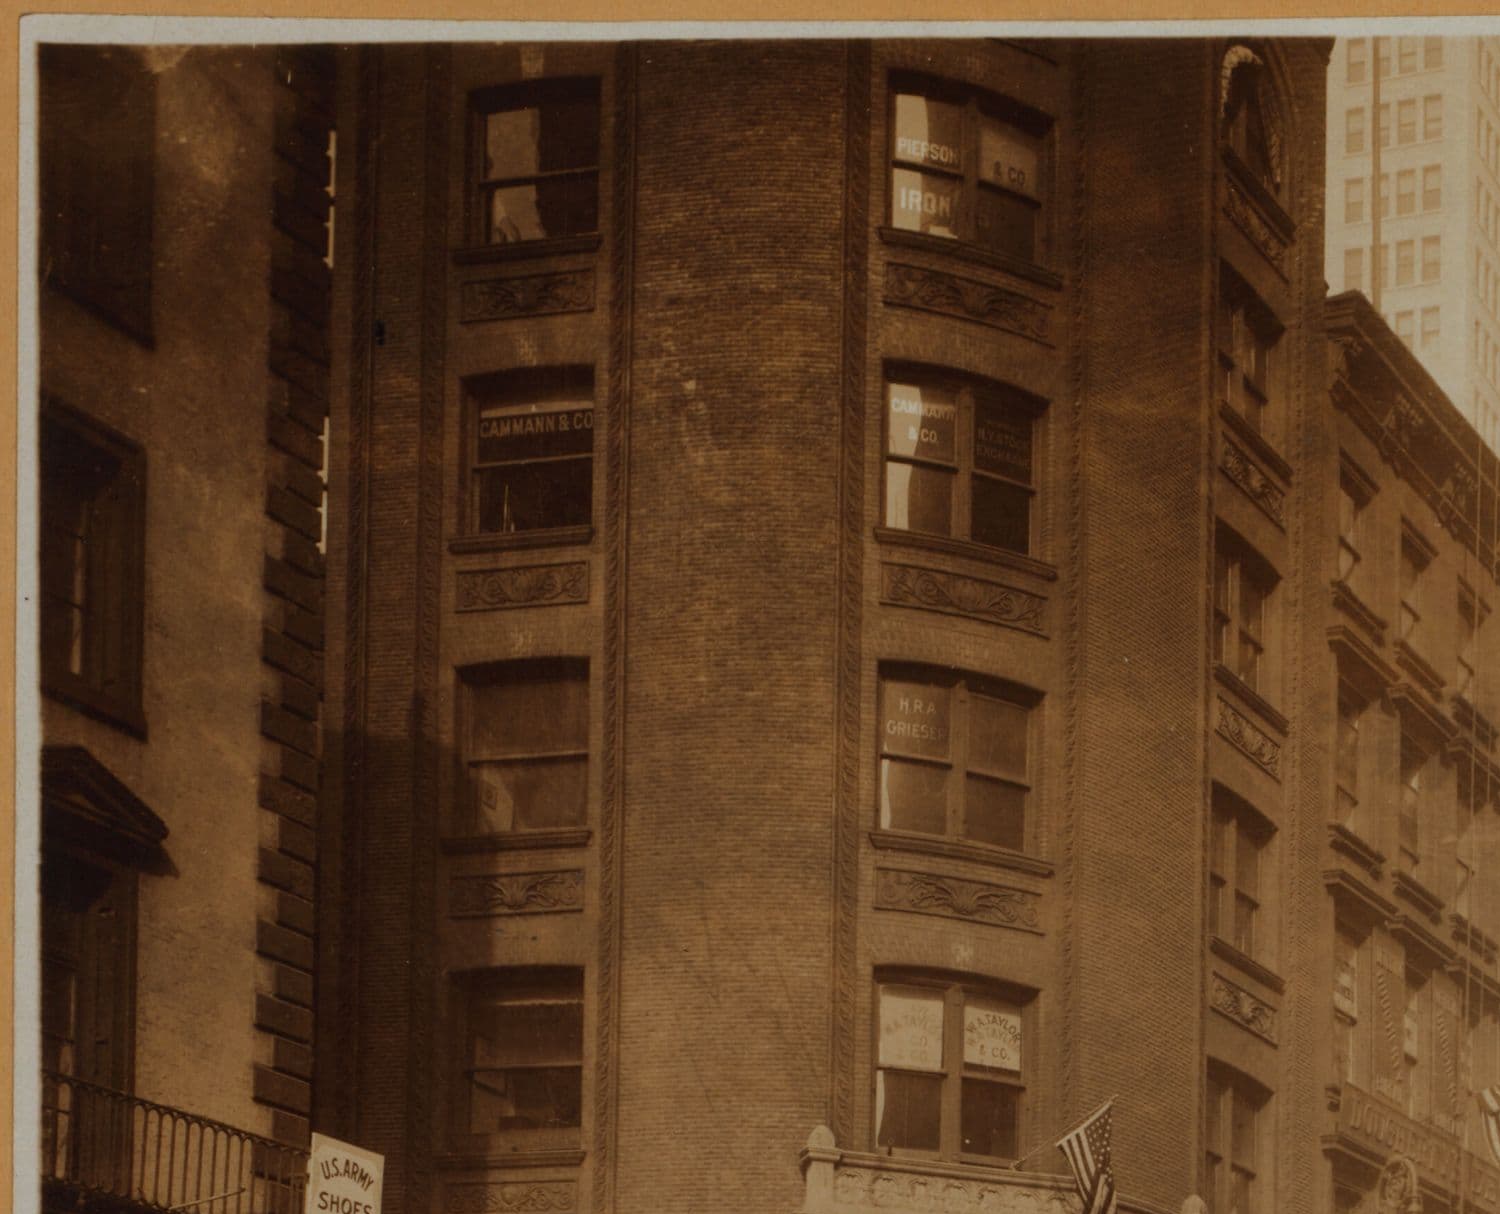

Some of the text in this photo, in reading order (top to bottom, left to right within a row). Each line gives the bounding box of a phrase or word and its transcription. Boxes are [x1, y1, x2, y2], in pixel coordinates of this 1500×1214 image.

[899, 187, 951, 217] IRON
[480, 415, 555, 438] CAMMANN
[558, 414, 569, 431] &
